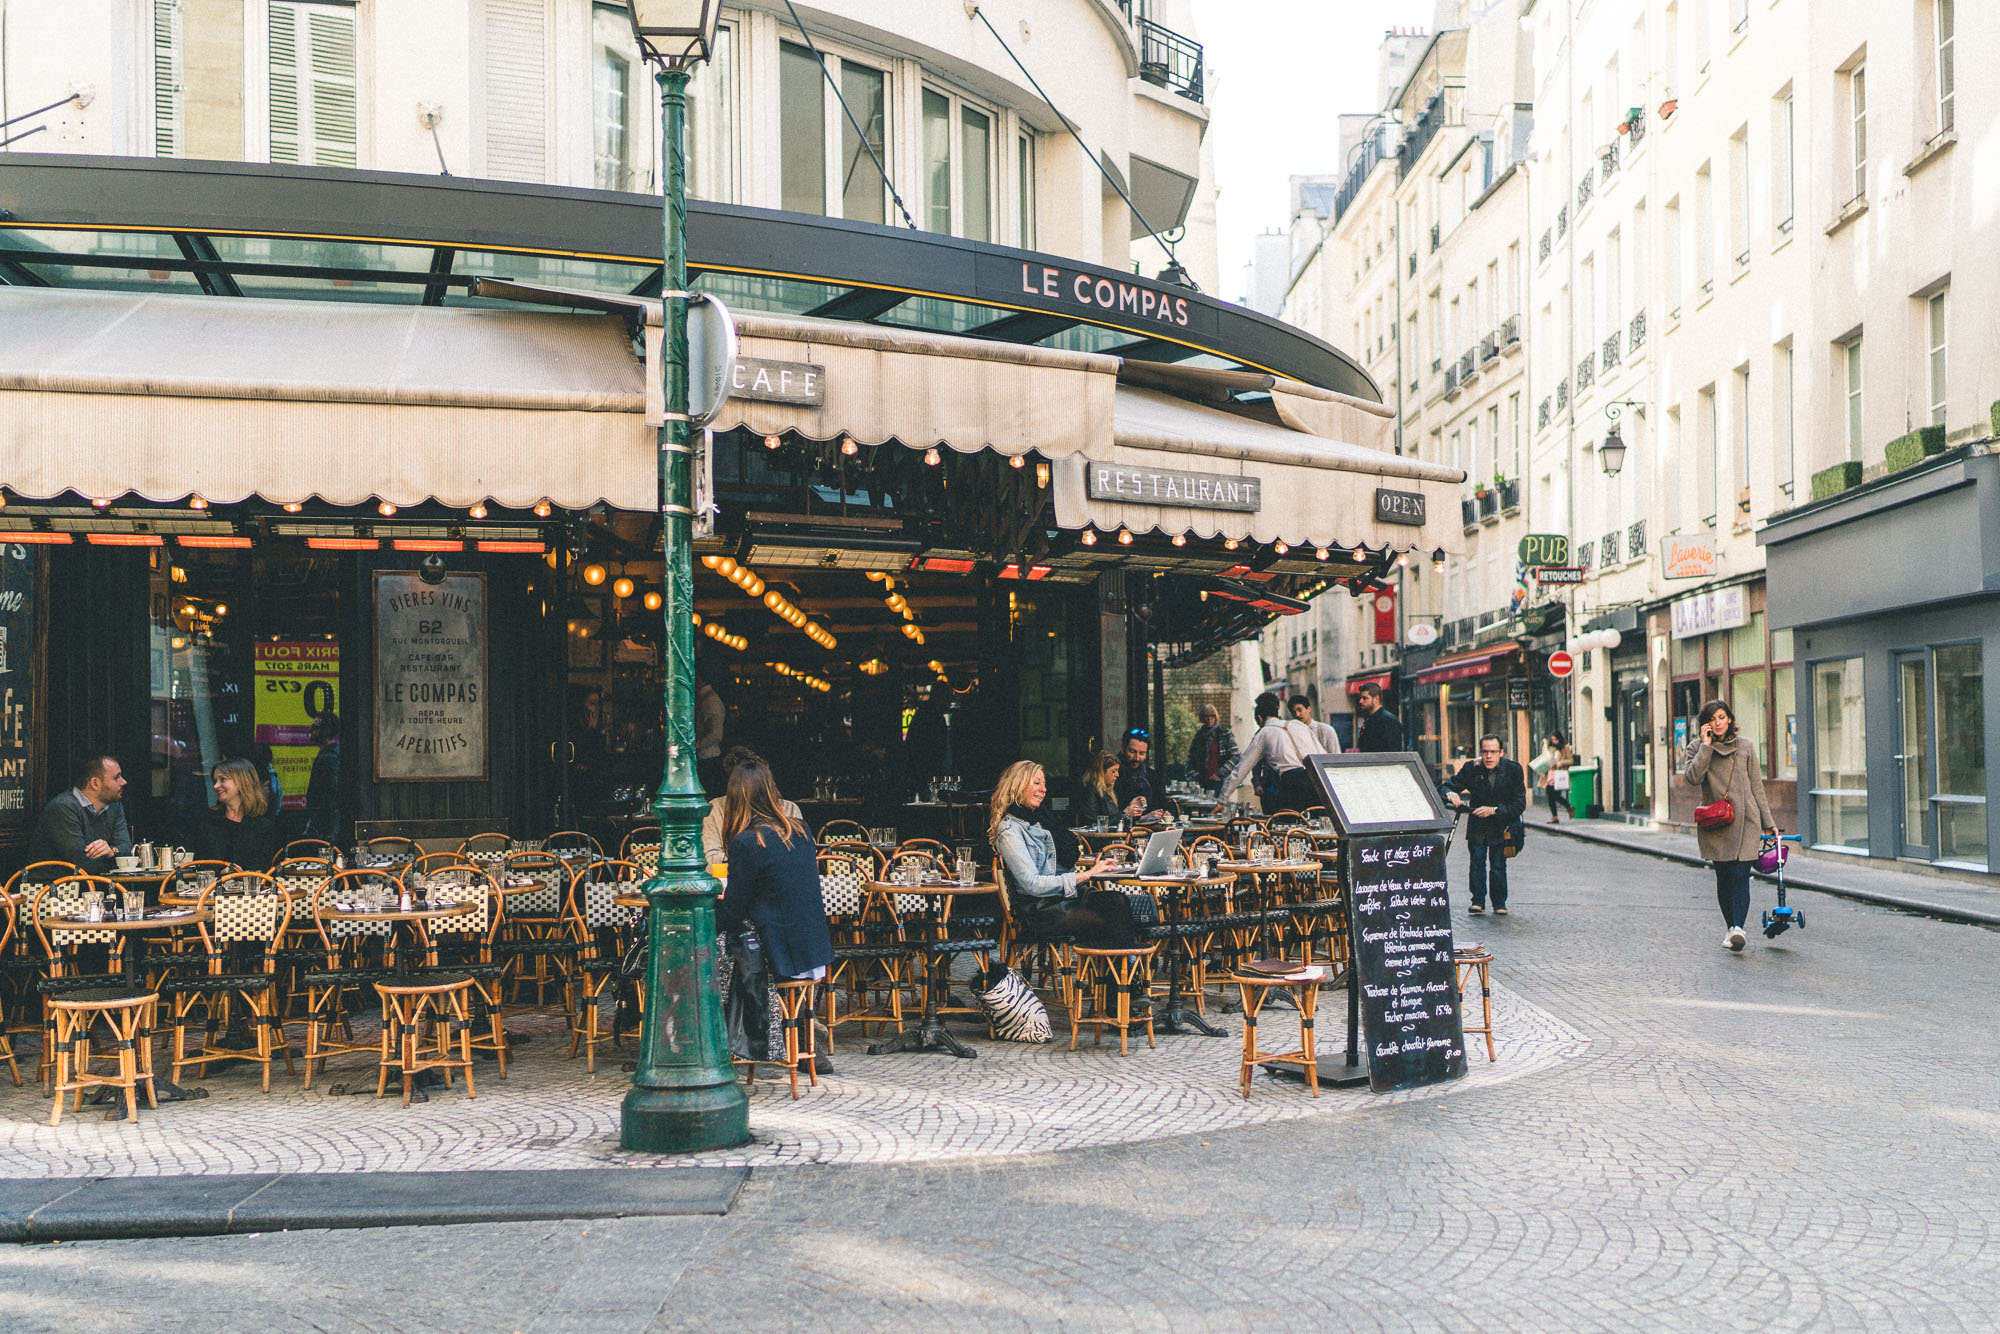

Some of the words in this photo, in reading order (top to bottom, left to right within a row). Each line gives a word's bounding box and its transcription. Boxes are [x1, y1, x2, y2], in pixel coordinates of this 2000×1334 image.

[1022, 263, 1060, 298] LE
[1073, 274, 1188, 326] COMPAS
[732, 364, 817, 397] CAFE
[1098, 469, 1254, 505] RESTAURANT
[1381, 493, 1424, 516] OPEN
[1525, 536, 1567, 564] PUB
[1667, 541, 1714, 571] Laverie
[1539, 570, 1581, 581] RETOUCHES
[389, 590, 435, 612] BIERES
[442, 591, 471, 613] VINS
[1676, 596, 1715, 632] LAVERIE
[419, 620, 442, 634] 62
[400, 664, 461, 672] RESTAURANT
[384, 683, 404, 703] LE
[409, 683, 477, 703] COMPAS
[0, 688, 24, 748] FE
[396, 733, 467, 754] APERITIFS
[1384, 848, 1393, 860] 17
[1413, 845, 1434, 857] 2017
[1380, 879, 1387, 892] de
[1404, 878, 1412, 890] et
[1389, 927, 1399, 939] de
[1403, 955, 1410, 966] de
[1390, 985, 1398, 996] de
[1426, 980, 1449, 993] Avocat
[1391, 997, 1399, 1009] et
[1401, 1035, 1425, 1052] chocolat
